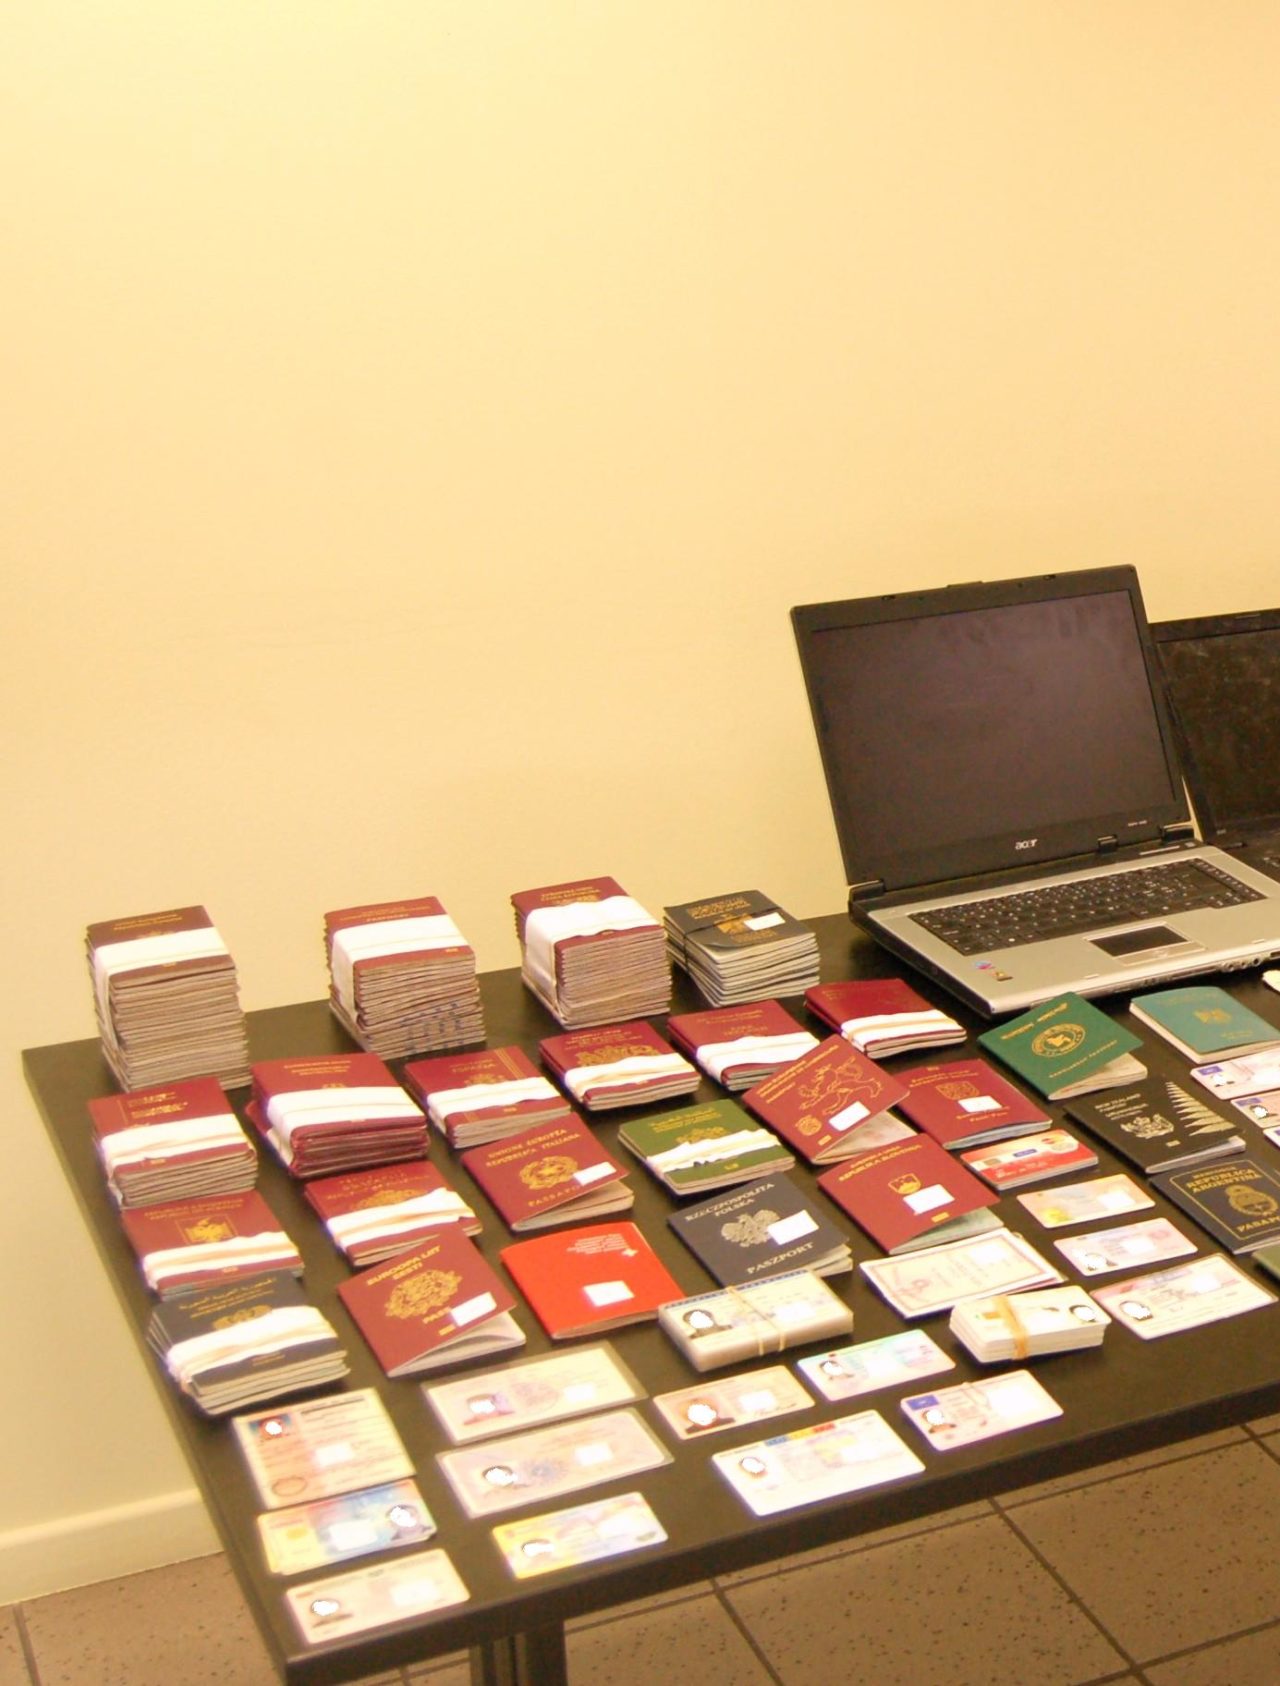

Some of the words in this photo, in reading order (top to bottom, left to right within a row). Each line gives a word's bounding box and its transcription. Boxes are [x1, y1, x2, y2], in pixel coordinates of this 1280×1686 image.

[1014, 838, 1038, 850] acer
[1192, 1173, 1263, 1193] ARGENTINA
[685, 1183, 775, 1222] RZECZPOSPOLITA
[715, 1198, 755, 1217] POLSKA
[746, 1241, 814, 1275] PASZPORT
